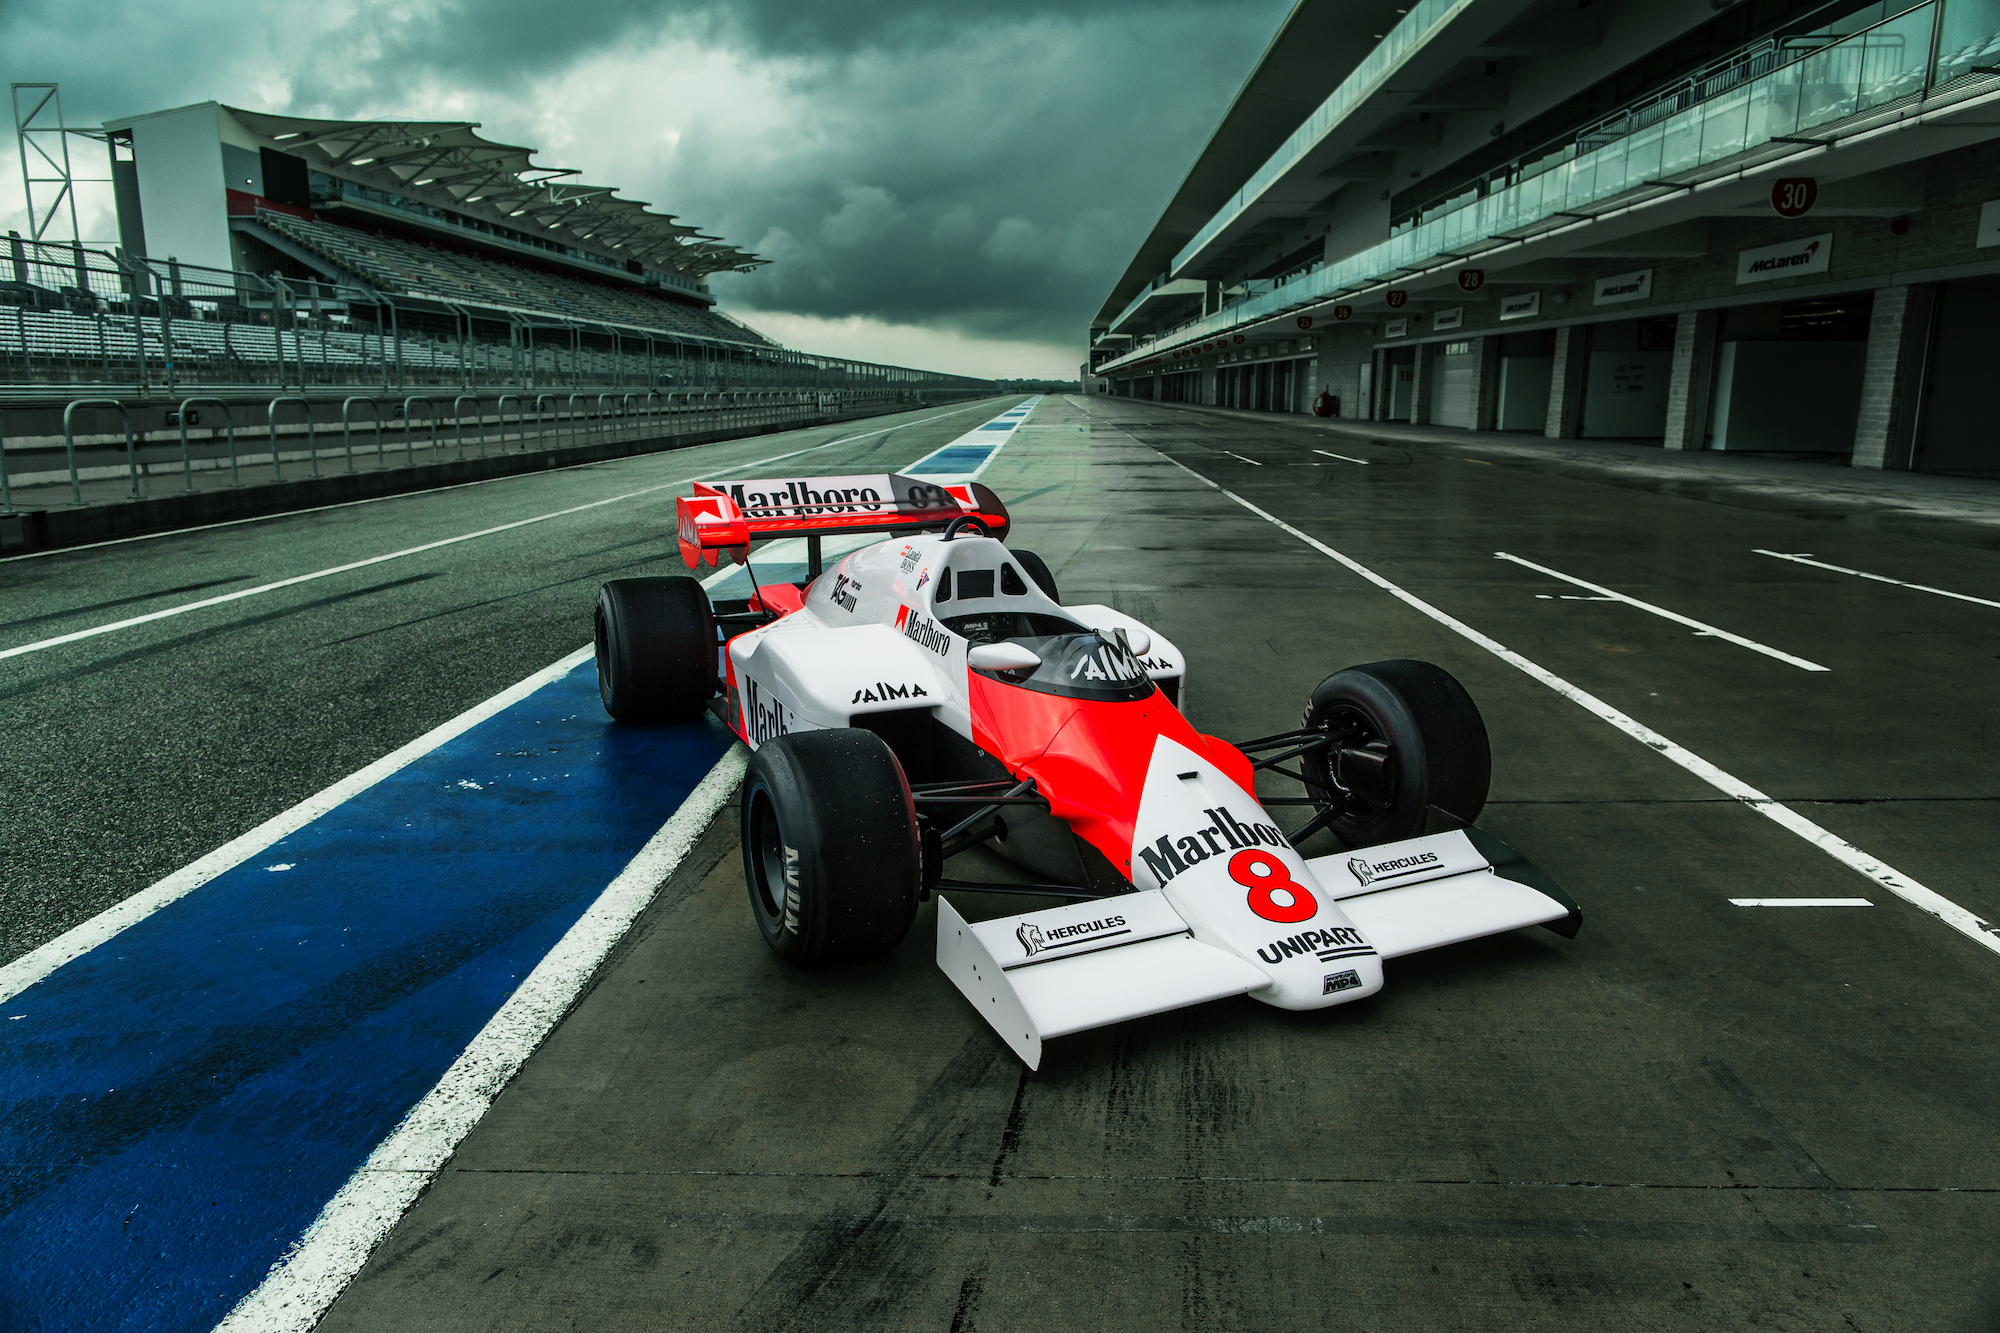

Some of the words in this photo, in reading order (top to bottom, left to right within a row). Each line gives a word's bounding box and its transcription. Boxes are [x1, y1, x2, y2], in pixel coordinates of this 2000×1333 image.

[1780, 183, 1808, 210] 30
[1748, 252, 1811, 274] McLaren
[1463, 271, 1480, 288] 28
[1601, 281, 1641, 298] McLaren
[1391, 292, 1404, 306] 27
[1300, 316, 1310, 328] 25
[1338, 306, 1349, 318] 26
[712, 482, 881, 518] Marlboro
[900, 558, 917, 574] BOSS
[904, 609, 951, 657] Marlboro
[852, 682, 928, 704] SAIMA
[1373, 853, 1439, 873] HERCULES
[784, 845, 801, 936] AVON
[1227, 848, 1319, 923] 8
[1046, 916, 1127, 941] HERCULES
[1256, 927, 1364, 964] UNIPART
[1326, 977, 1359, 992] MP4
